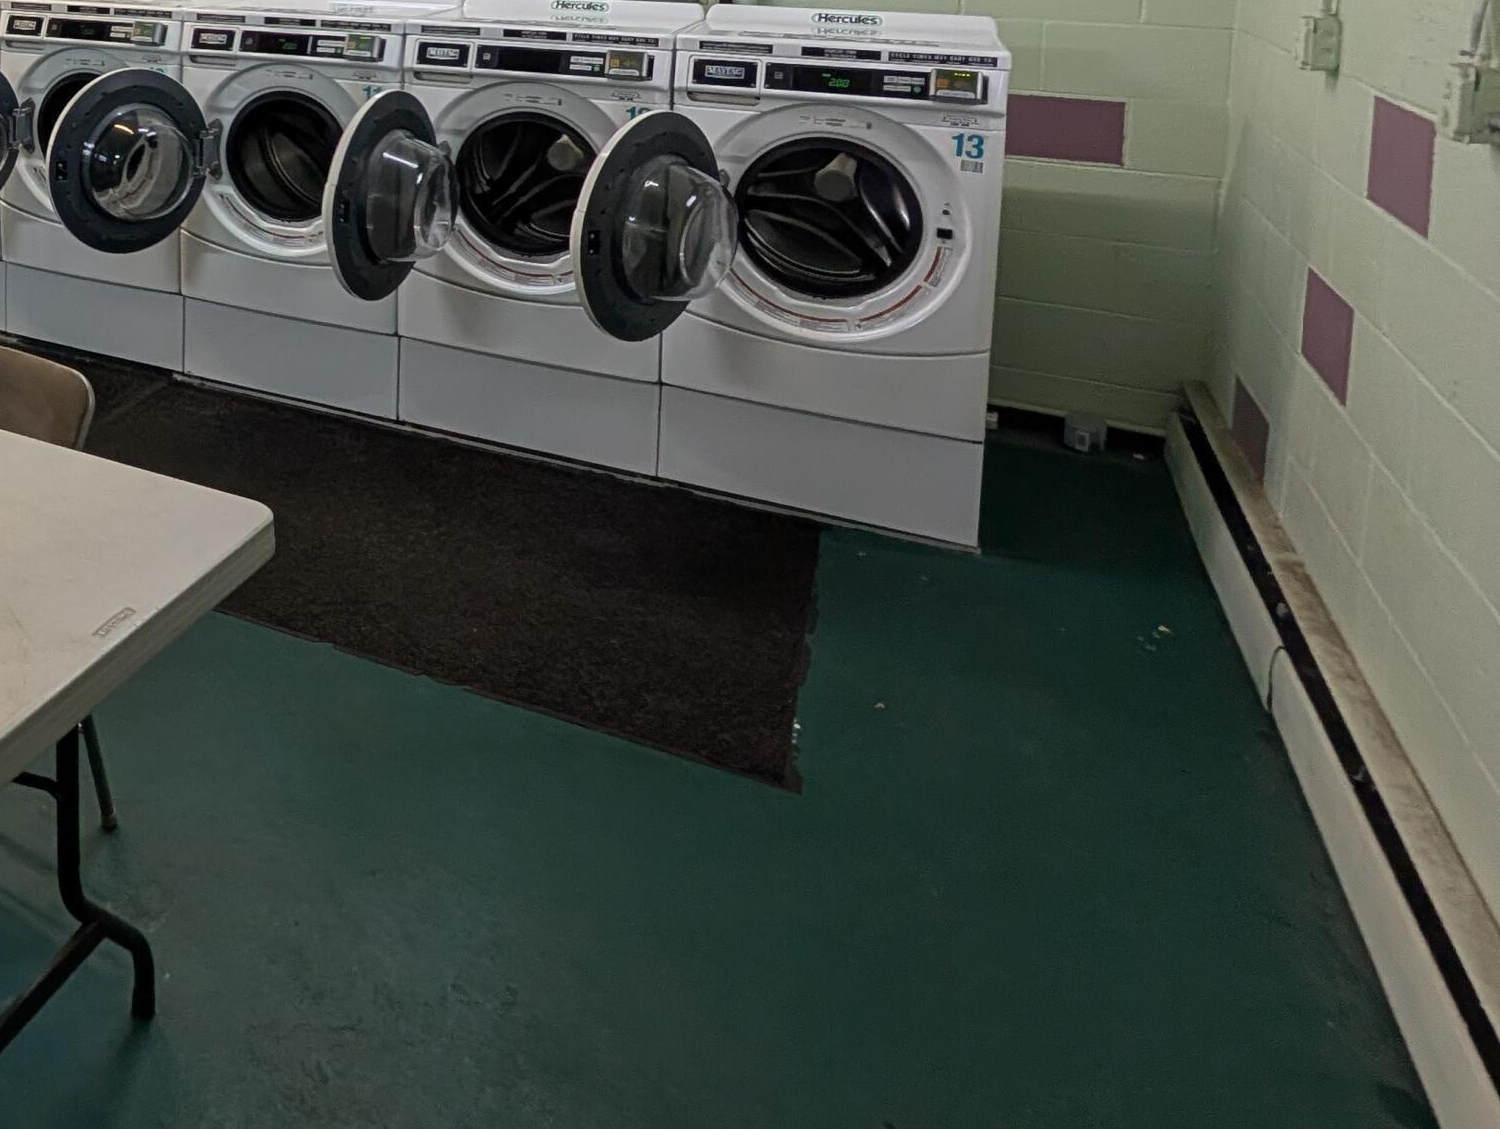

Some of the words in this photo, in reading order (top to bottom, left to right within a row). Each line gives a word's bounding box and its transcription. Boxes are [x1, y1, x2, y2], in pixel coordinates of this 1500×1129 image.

[555, 0, 606, 12] Hercules
[817, 12, 878, 25] Hercules
[952, 132, 985, 160] 13
